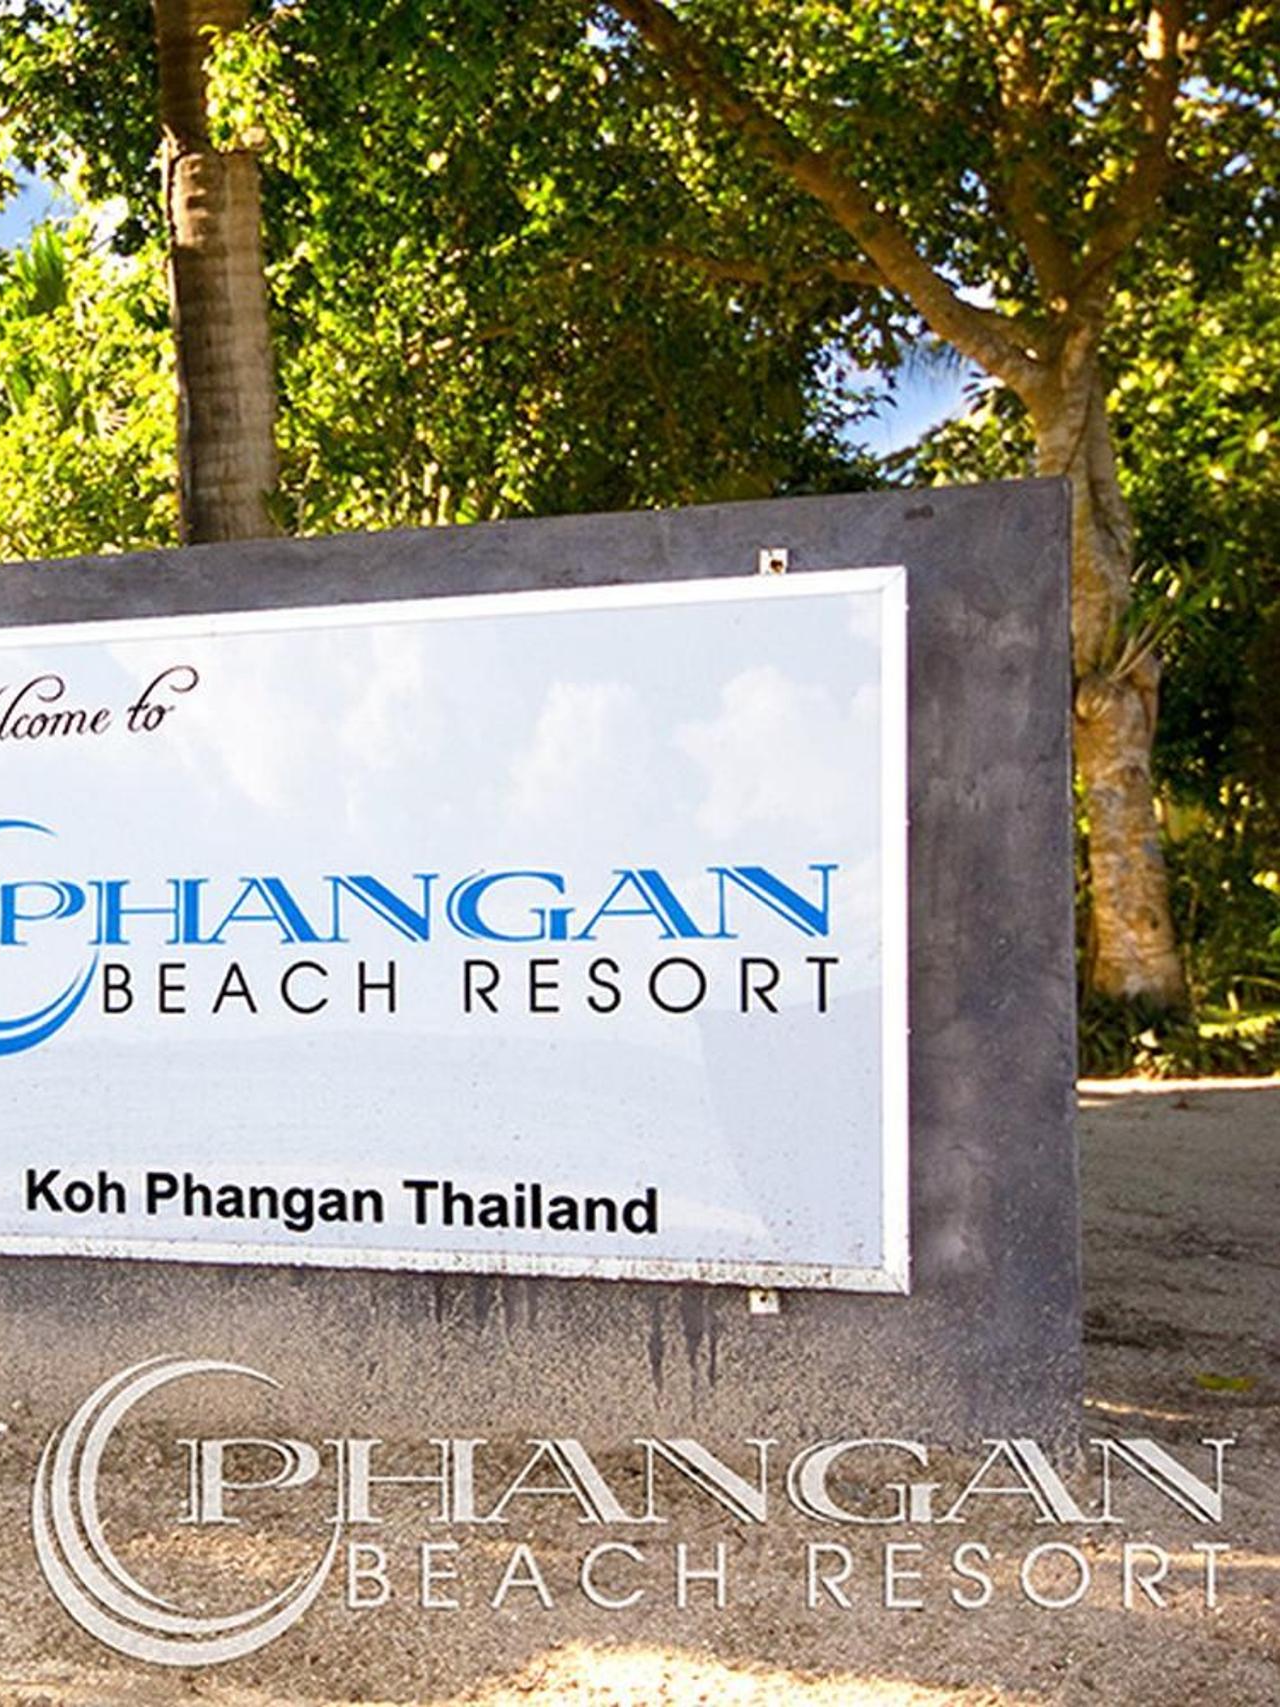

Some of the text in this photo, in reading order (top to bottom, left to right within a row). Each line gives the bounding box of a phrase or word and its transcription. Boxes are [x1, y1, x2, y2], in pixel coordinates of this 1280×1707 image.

[126, 664, 200, 733] to
[103, 955, 840, 1015] BEACH RESORT
[25, 1168, 659, 1235] Koh Phangan Thailand
